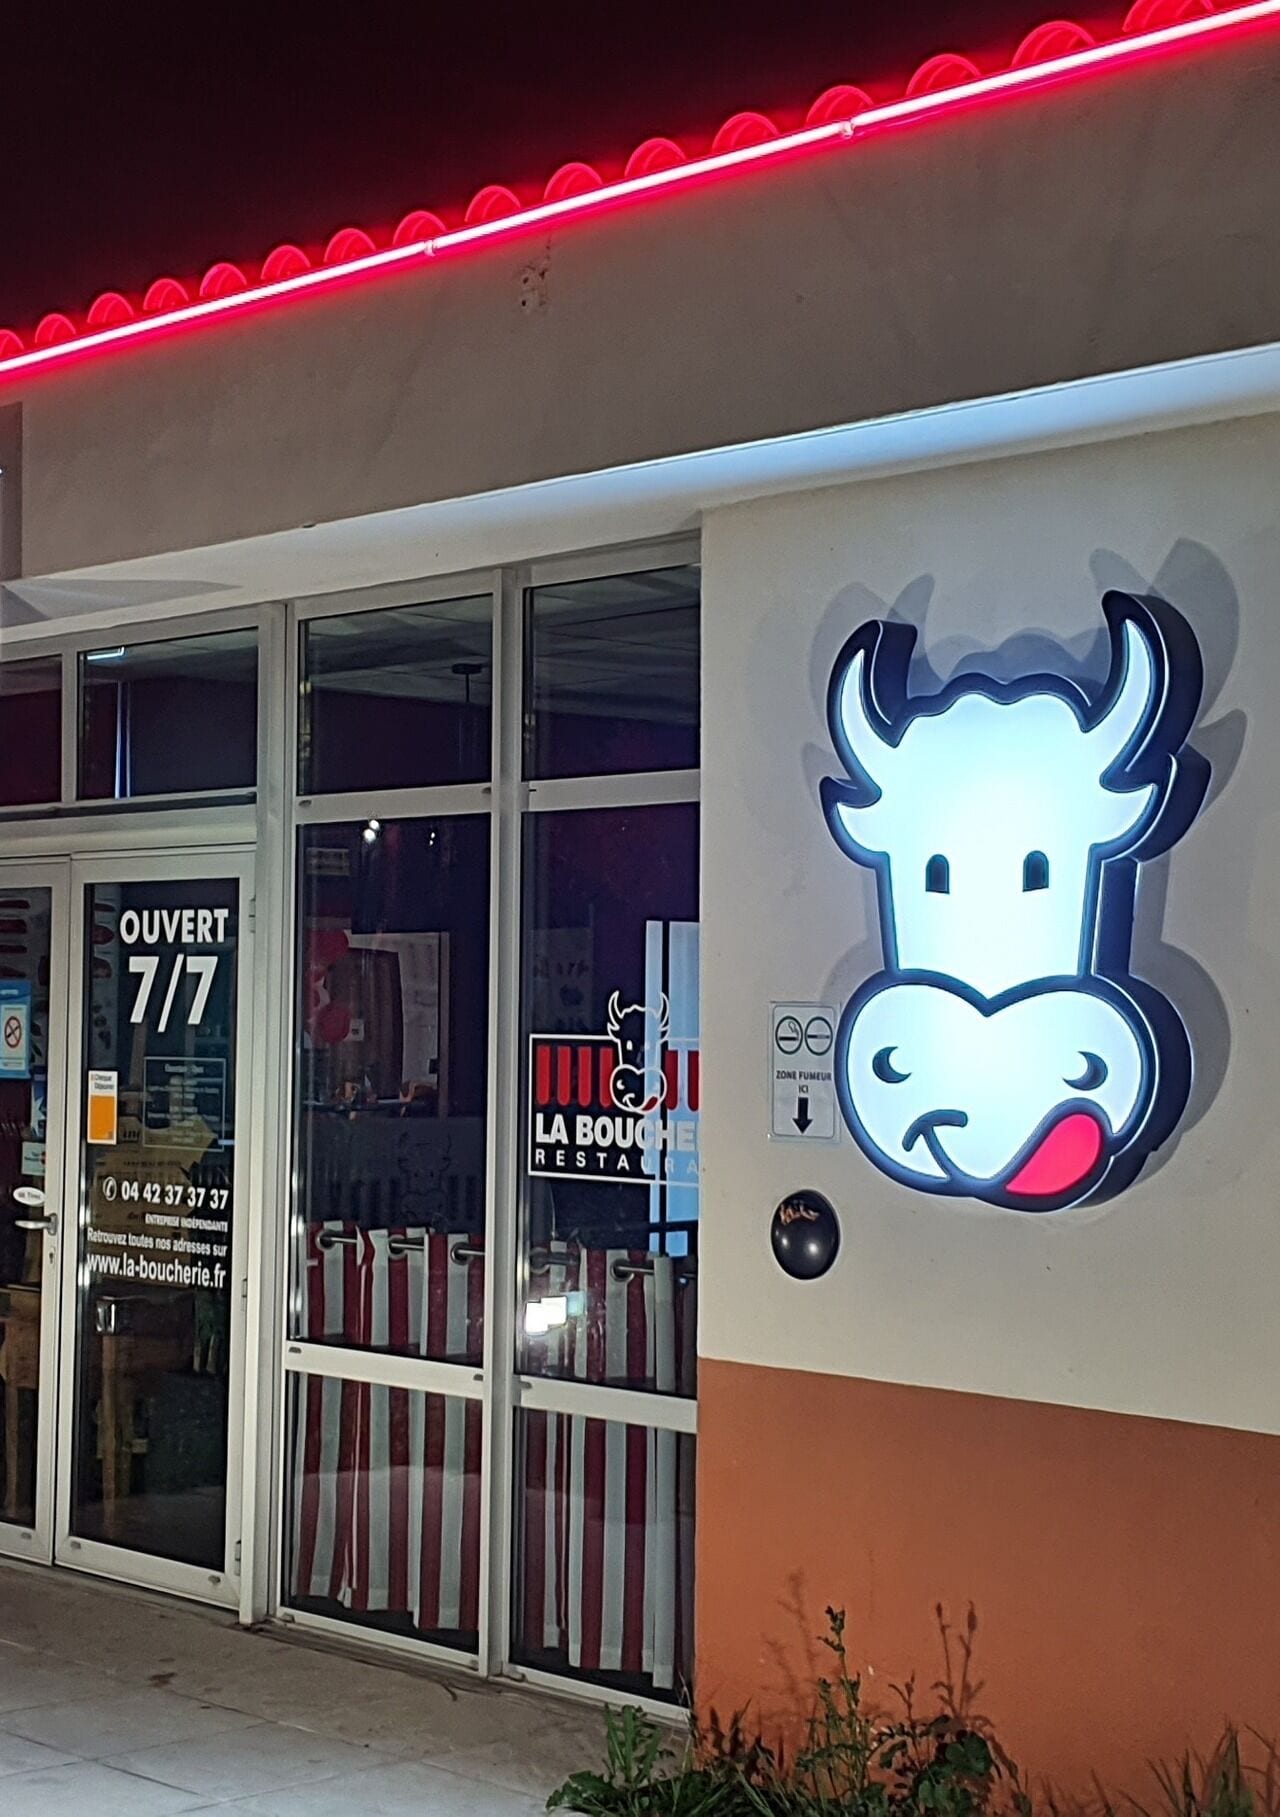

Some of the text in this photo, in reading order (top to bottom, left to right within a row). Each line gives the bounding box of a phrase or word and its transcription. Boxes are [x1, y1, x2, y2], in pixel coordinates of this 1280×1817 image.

[120, 908, 229, 944] OUVERT
[129, 954, 218, 1032] 7/7
[776, 1070, 832, 1081] ZONE FUMEUR
[799, 1084, 809, 1093] ICI
[535, 1113, 699, 1151] LA BOUCHE
[121, 1181, 229, 1210] 04 42 37 37 37
[87, 1227, 228, 1257] Retrouvez toutes nos adresses sur
[87, 1252, 226, 1288] www.la-boucherie.fr
